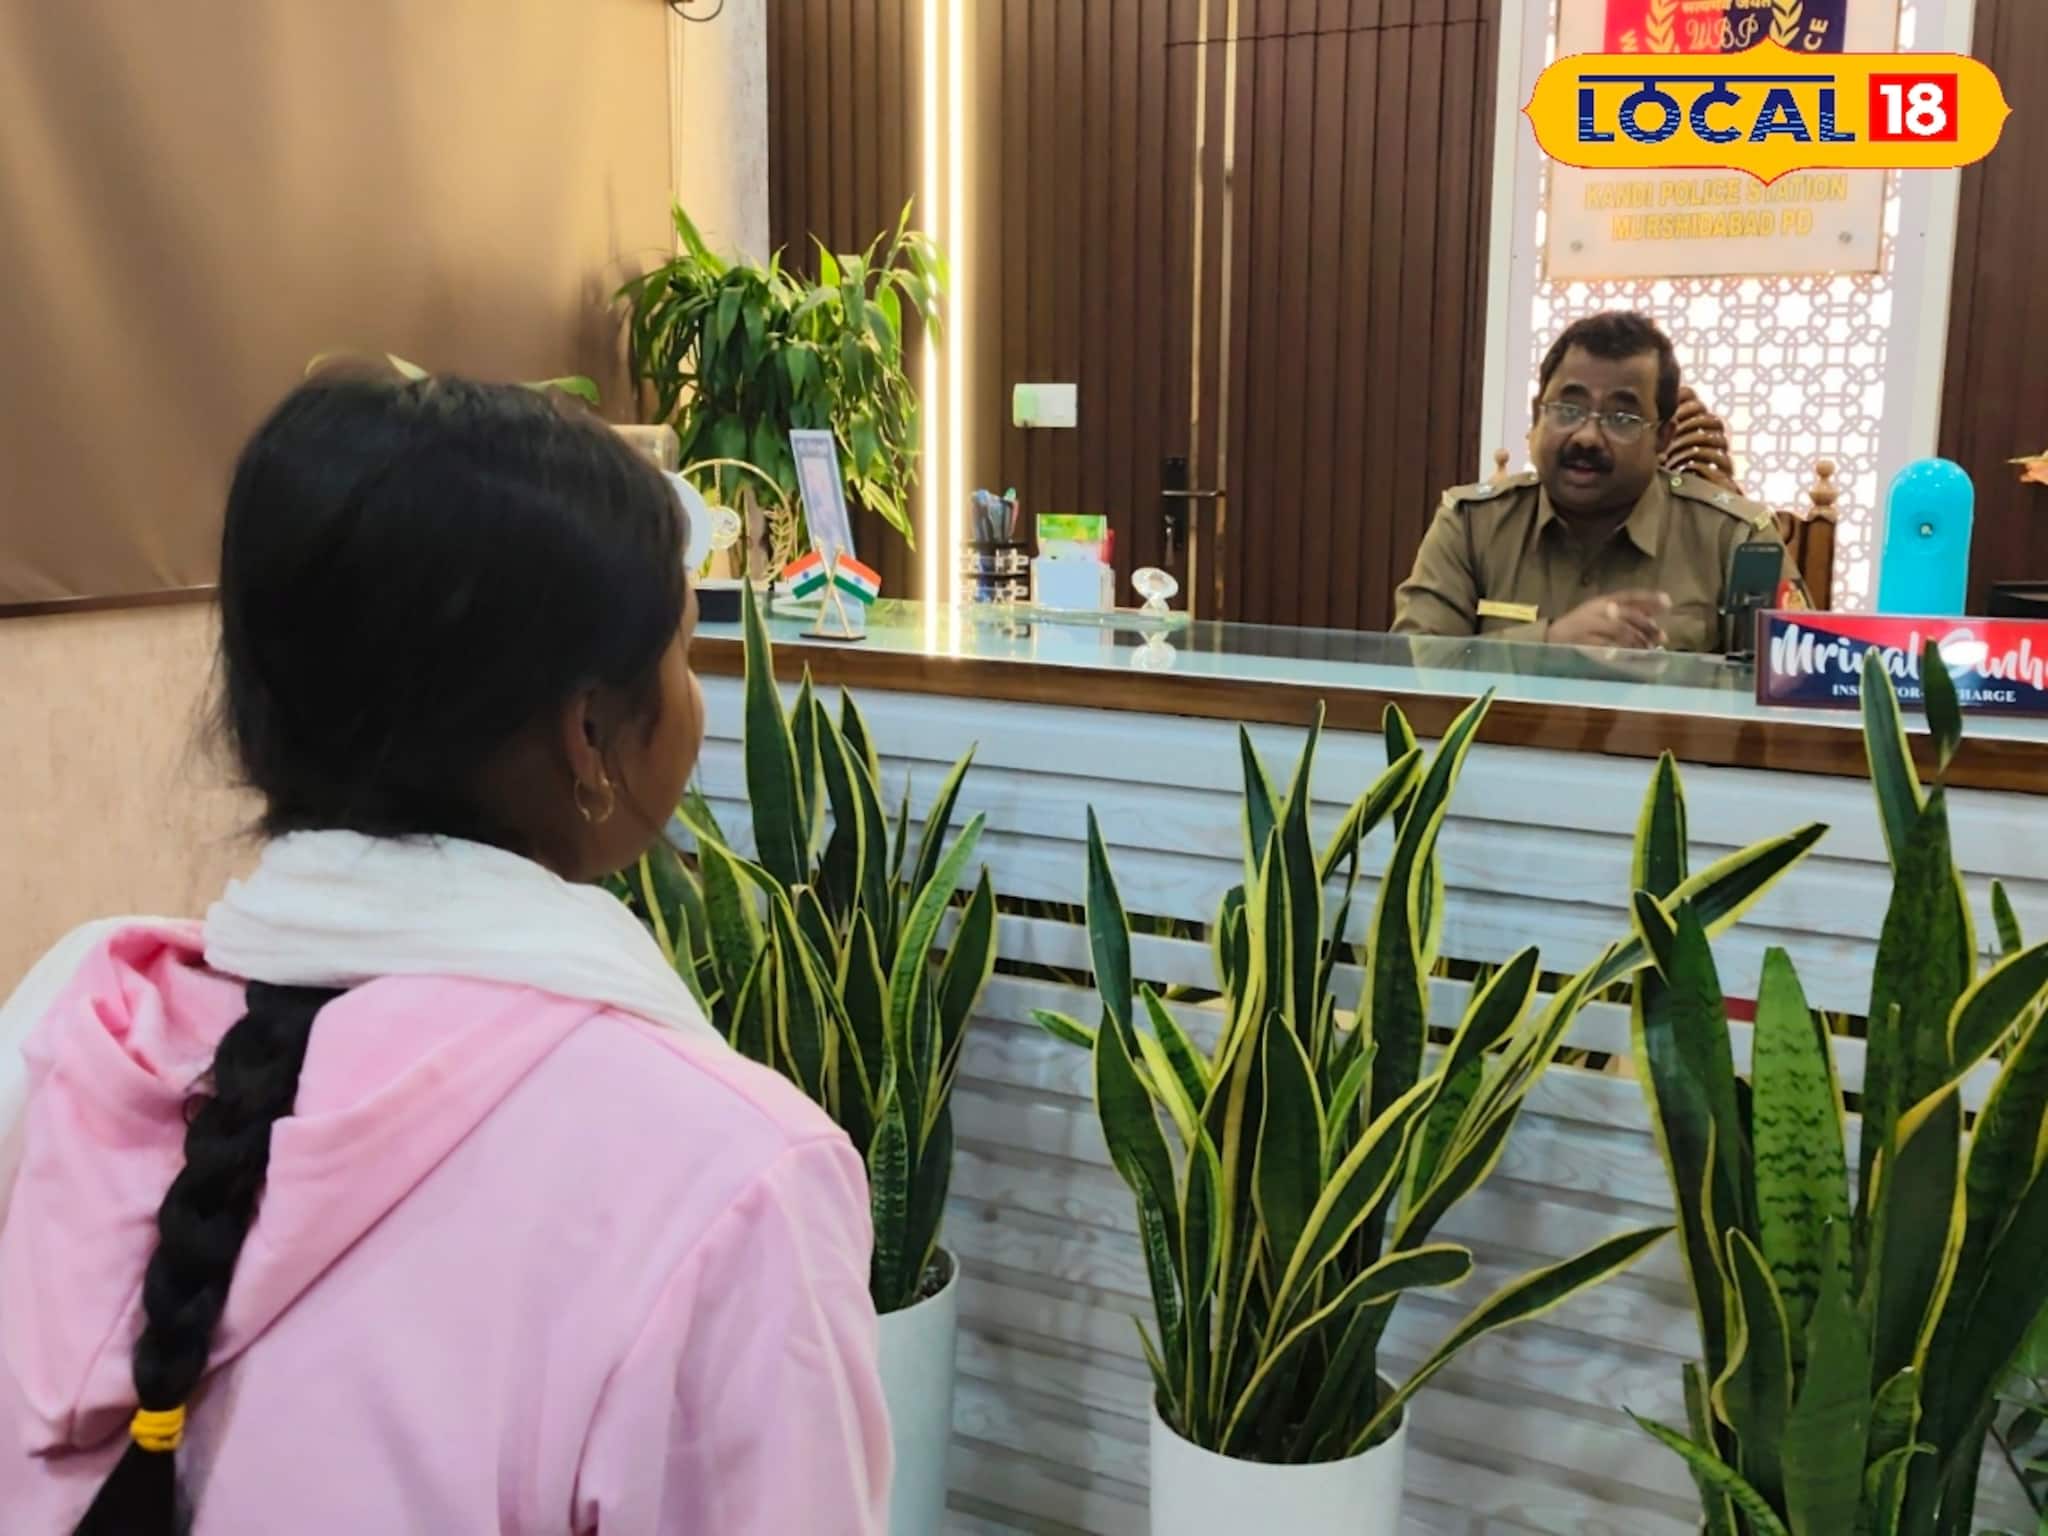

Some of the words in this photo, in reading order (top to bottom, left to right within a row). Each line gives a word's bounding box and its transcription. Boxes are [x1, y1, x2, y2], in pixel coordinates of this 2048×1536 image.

[1584, 182, 1653, 209] KANDI
[1659, 177, 1742, 207] POLICE
[1612, 210, 1776, 240] MURSHIDABAD
[1781, 207, 1813, 236] PD
